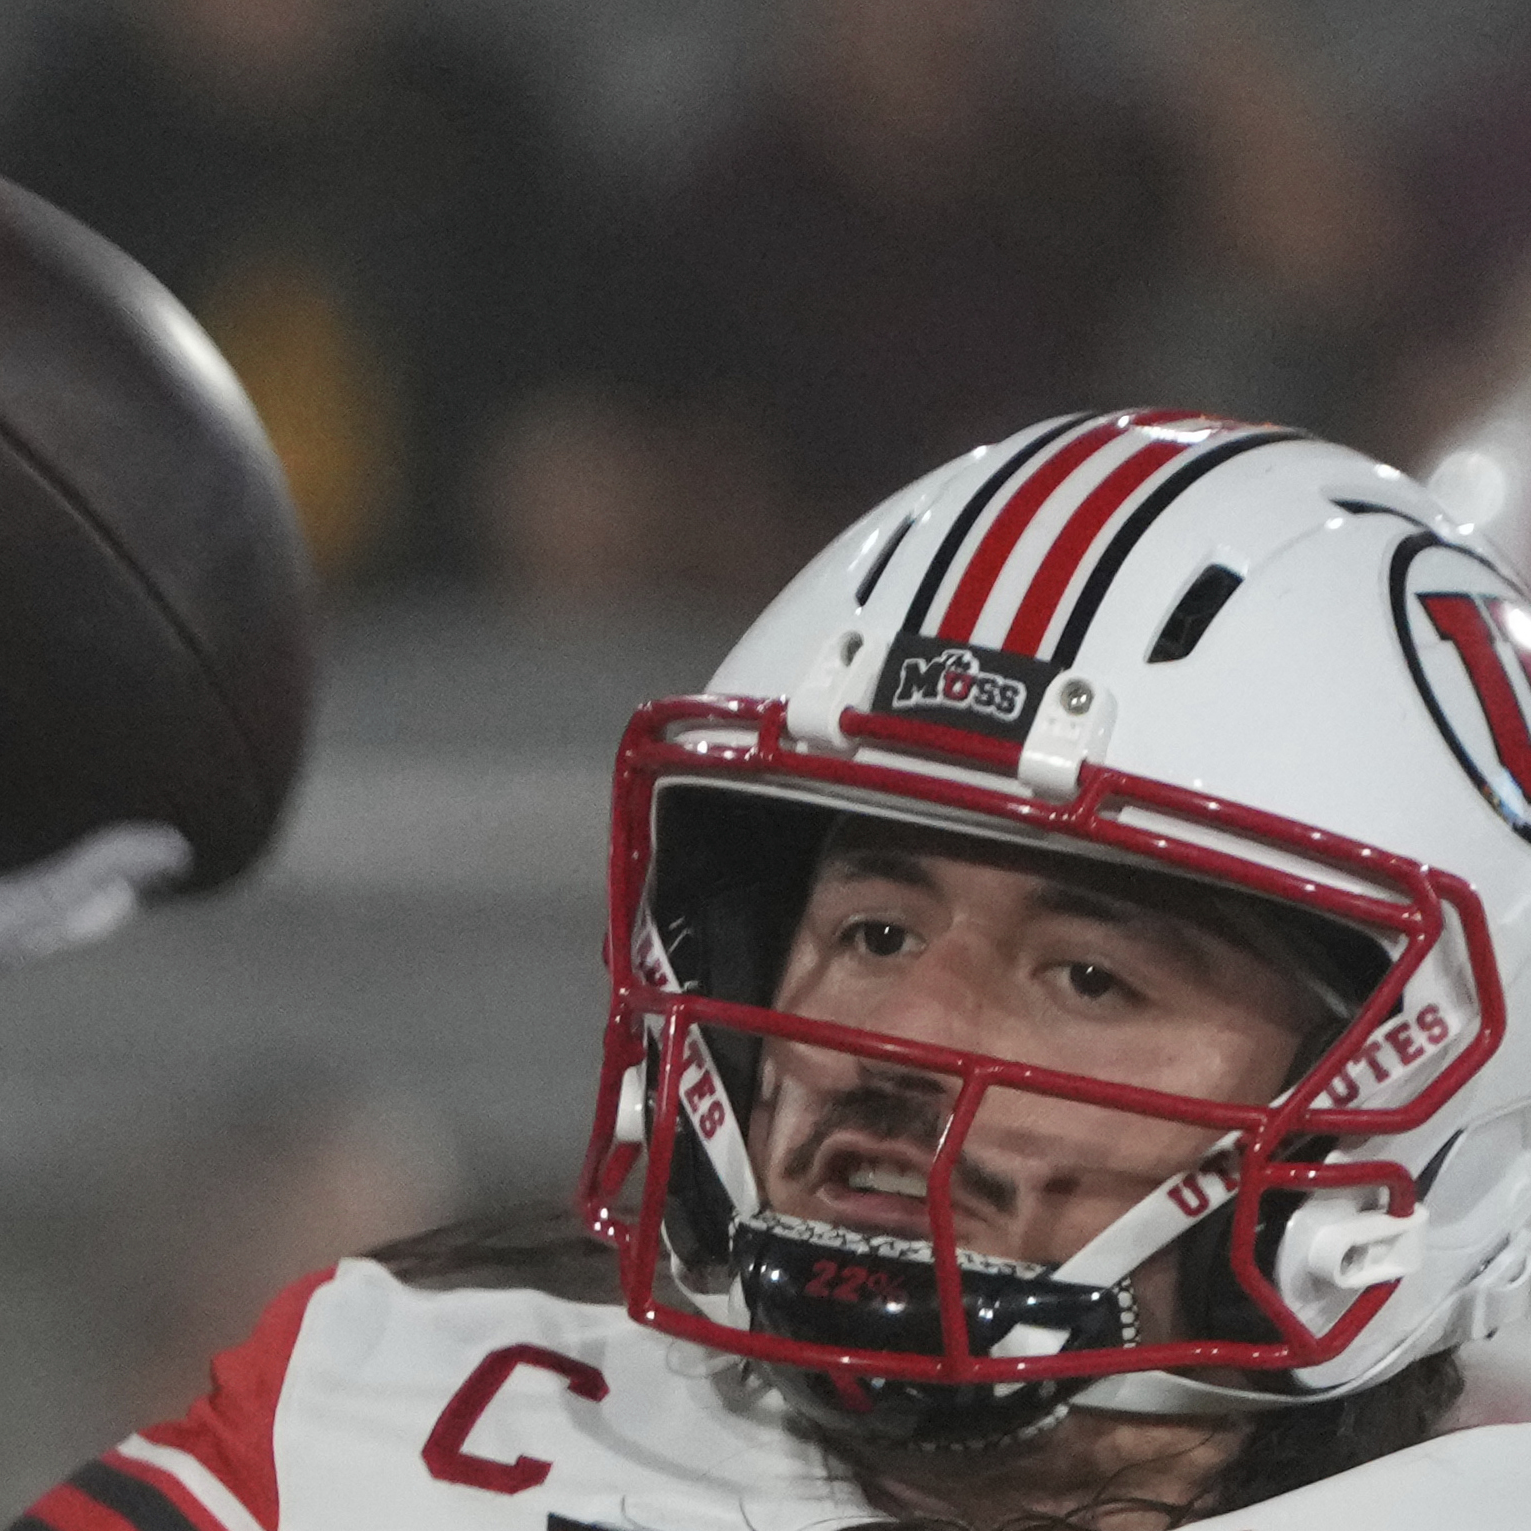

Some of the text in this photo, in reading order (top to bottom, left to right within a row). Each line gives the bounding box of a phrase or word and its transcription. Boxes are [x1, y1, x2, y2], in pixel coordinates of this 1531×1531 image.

[677, 1038, 726, 1140] TES
[1324, 1002, 1451, 1108] UTES
[422, 1343, 609, 1495] C
